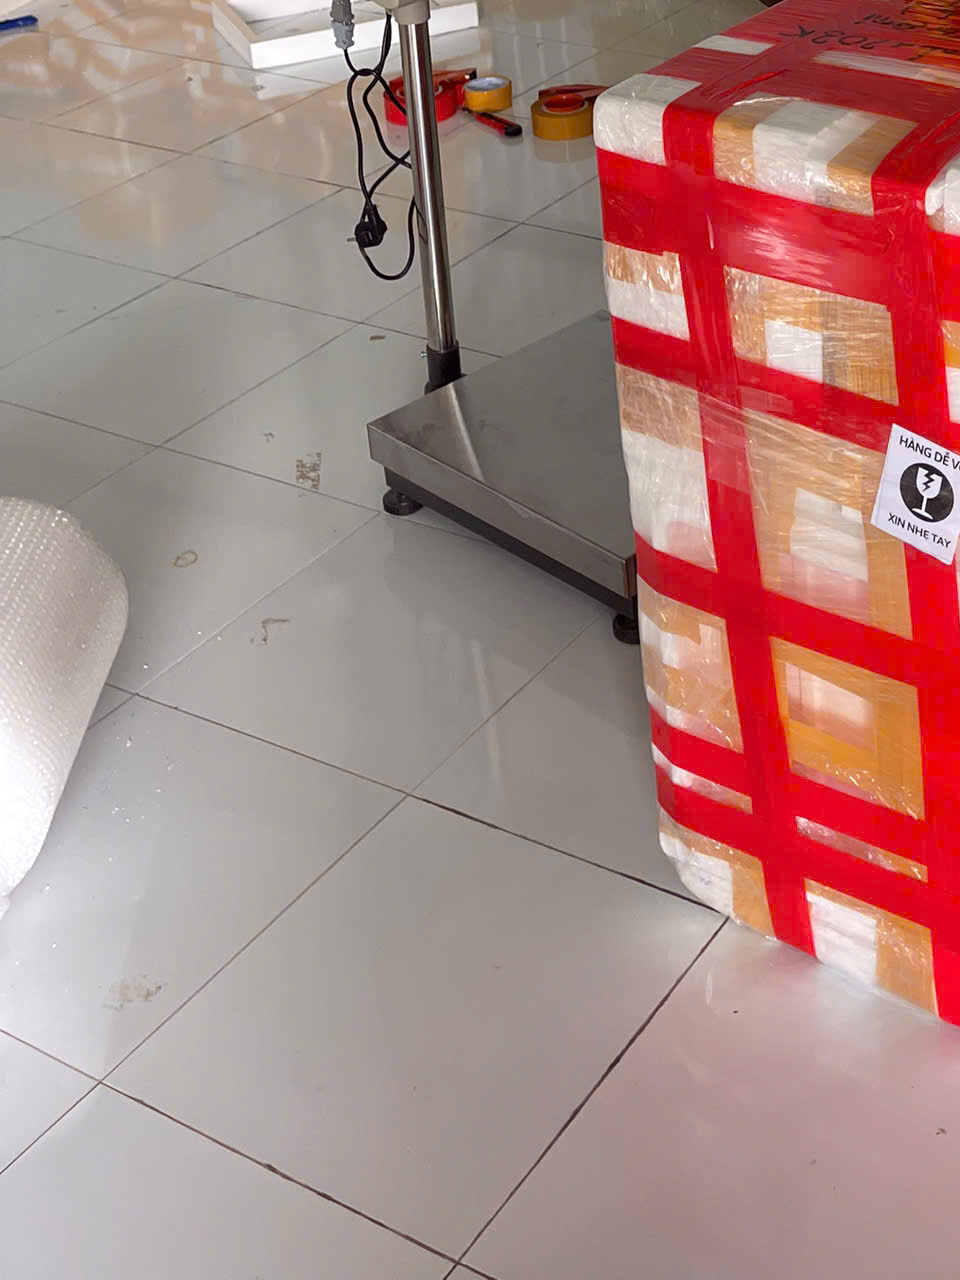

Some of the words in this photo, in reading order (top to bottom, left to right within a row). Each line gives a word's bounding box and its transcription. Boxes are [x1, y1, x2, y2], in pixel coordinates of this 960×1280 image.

[899, 435, 932, 458] HÀNG
[934, 451, 950, 466] DỄ
[888, 513, 905, 529] XIN
[907, 522, 929, 542] NHẸ
[931, 533, 951, 549] TAY
